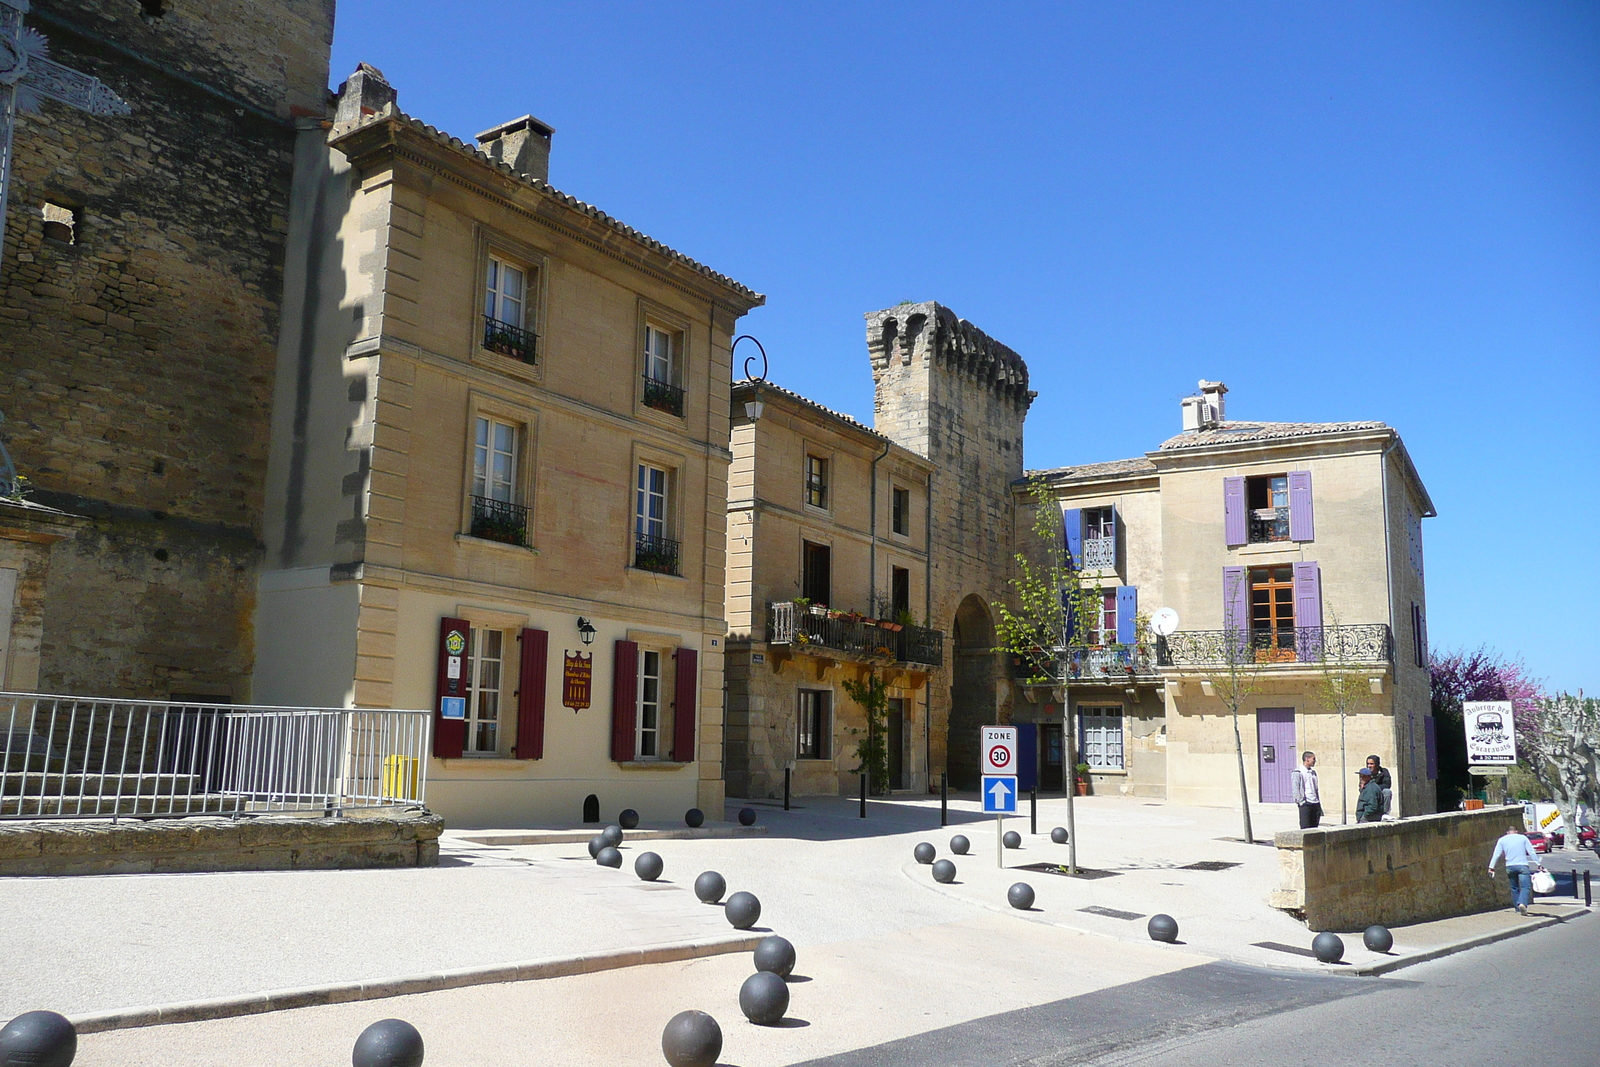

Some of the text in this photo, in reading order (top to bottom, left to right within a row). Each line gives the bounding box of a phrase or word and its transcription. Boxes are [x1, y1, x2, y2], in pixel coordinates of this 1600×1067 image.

[1465, 704, 1511, 716] Auberge des
[988, 732, 1011, 740] ZONE
[993, 751, 1006, 762] 30
